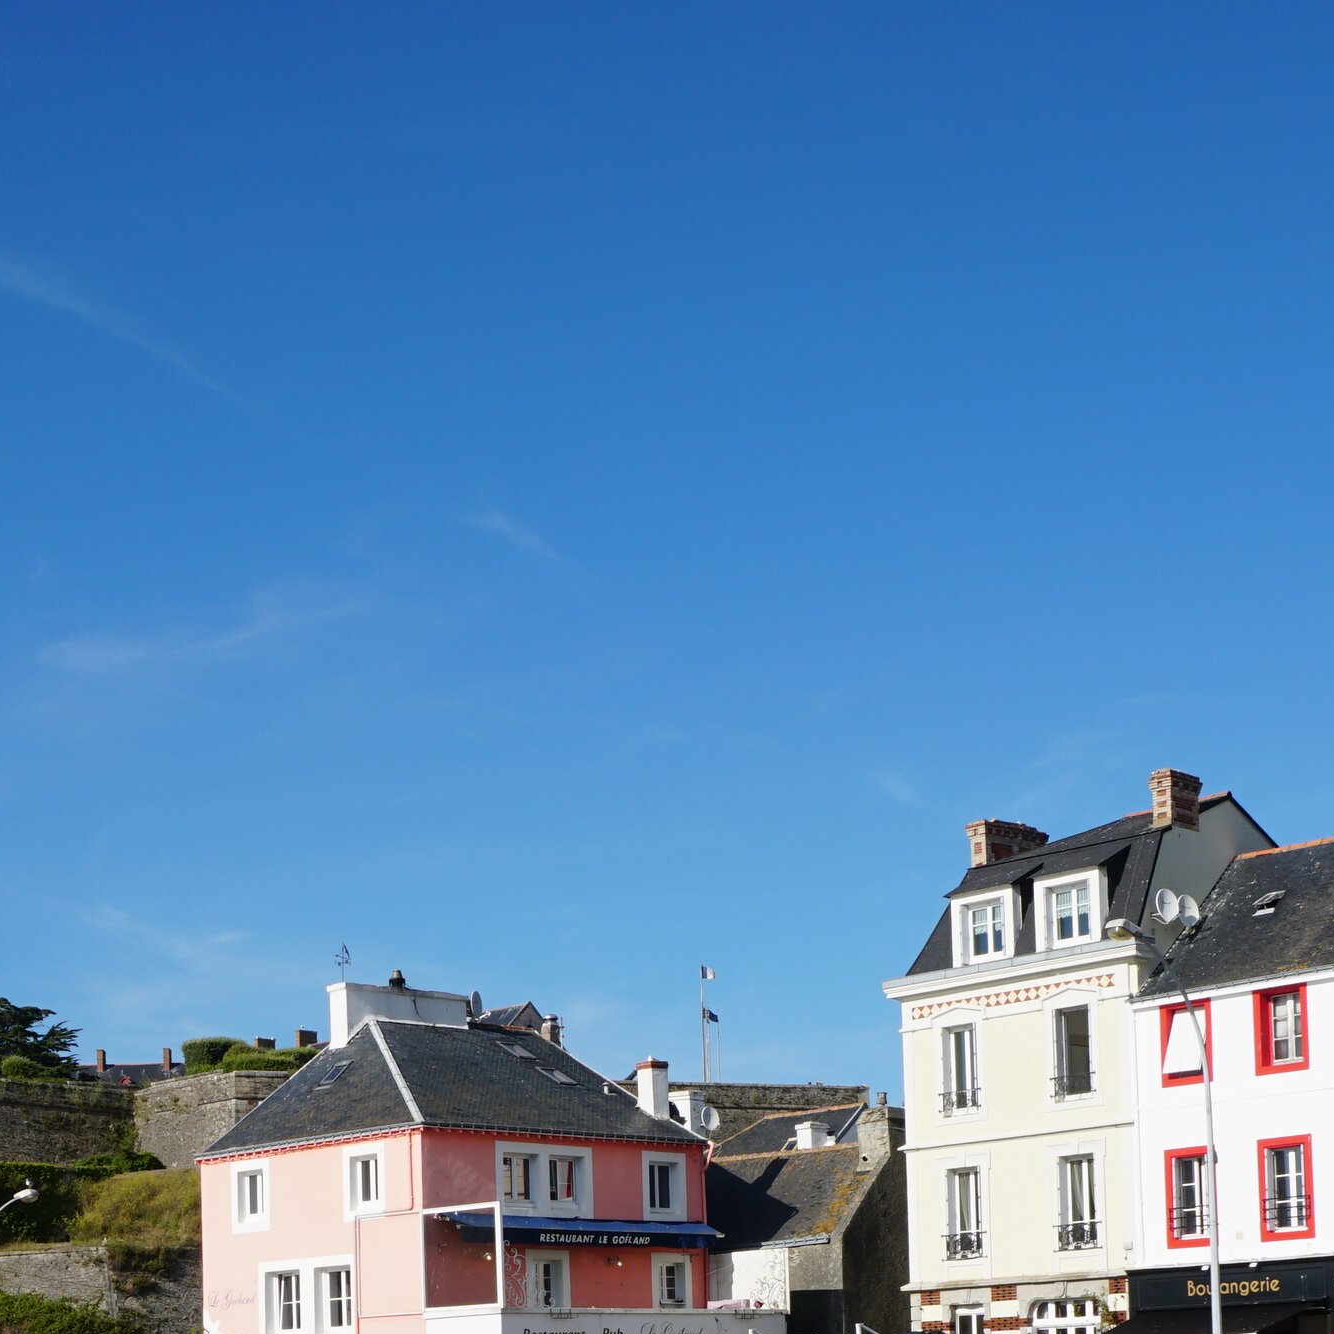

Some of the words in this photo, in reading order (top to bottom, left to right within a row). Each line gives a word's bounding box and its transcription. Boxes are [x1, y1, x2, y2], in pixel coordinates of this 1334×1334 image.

[539, 1233, 595, 1244] RESTAURANT
[598, 1235, 608, 1244] LE
[1186, 1276, 1281, 1297] Bouangerie
